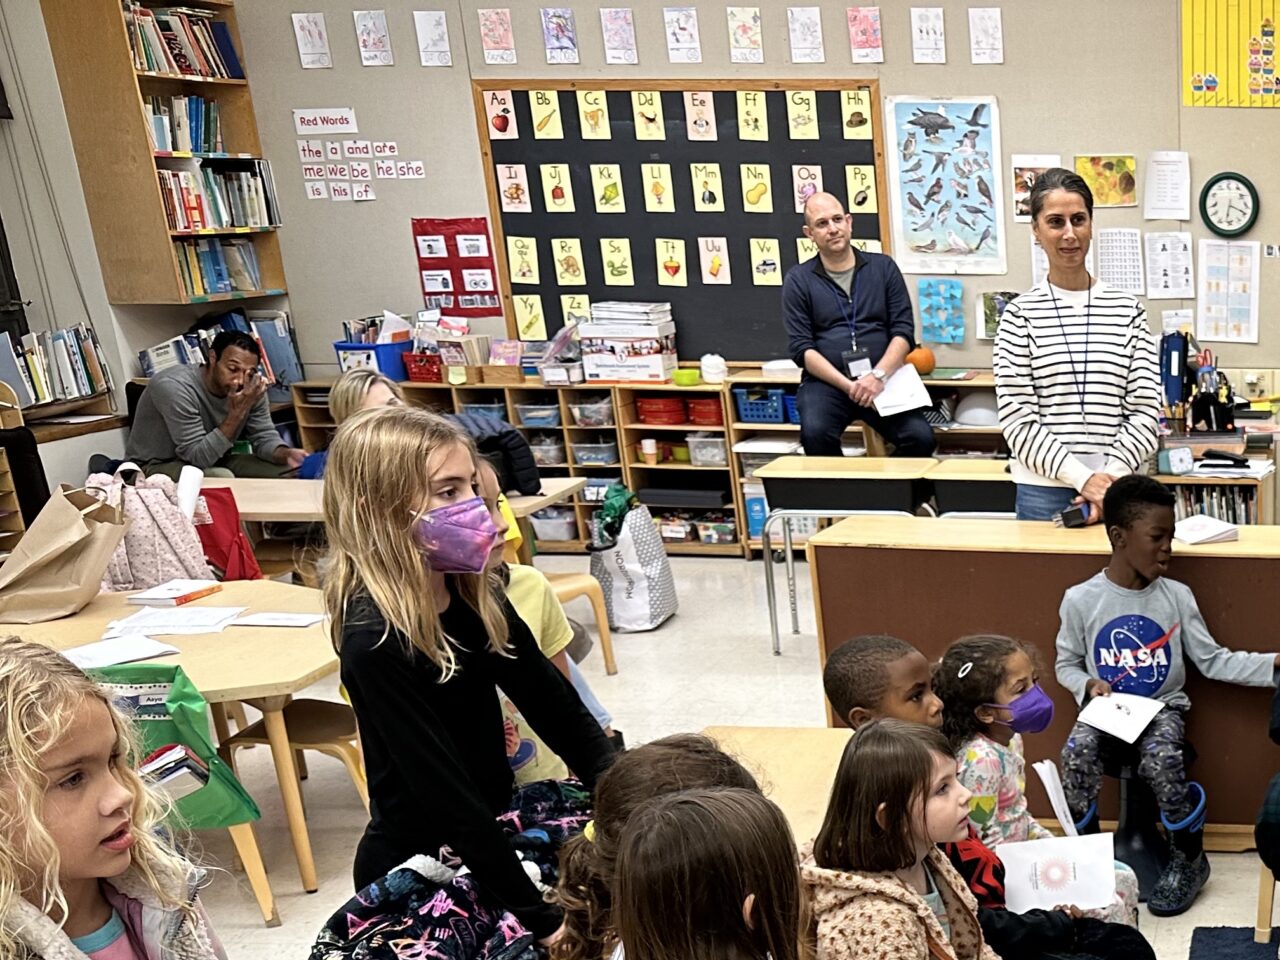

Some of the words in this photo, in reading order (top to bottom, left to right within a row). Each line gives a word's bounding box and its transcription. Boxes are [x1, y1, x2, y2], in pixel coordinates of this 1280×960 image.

[491, 92, 506, 106] Aa
[536, 92, 551, 106] Bb
[584, 92, 599, 106] Cc
[638, 93, 653, 106] Dd
[691, 93, 706, 107] Ee
[745, 93, 758, 107] Ff
[792, 92, 811, 112] Gg
[847, 92, 863, 106] Hh
[299, 116, 318, 127] Red
[319, 115, 350, 126] Words
[301, 144, 322, 158] the
[330, 146, 338, 155] a
[347, 144, 370, 155] and
[375, 143, 396, 153] are
[304, 166, 325, 177] me
[327, 165, 347, 177] we
[351, 165, 369, 179] be
[376, 162, 393, 176] he
[399, 162, 424, 176] she
[549, 165, 562, 185] Jj
[599, 166, 613, 180] Kk
[694, 165, 717, 179] Mm
[746, 166, 764, 180] Nn
[798, 167, 817, 181] Oo
[853, 167, 867, 187] Pp
[311, 185, 322, 197] is
[332, 186, 348, 197] his
[356, 185, 370, 198] of
[560, 240, 572, 254] Rr
[609, 240, 622, 253] Ss
[663, 240, 676, 254] Tt
[705, 239, 721, 253] Uu
[757, 240, 771, 253] Vv
[520, 297, 534, 315] Yy
[568, 297, 582, 310] Zz
[1099, 648, 1169, 668] NASA
